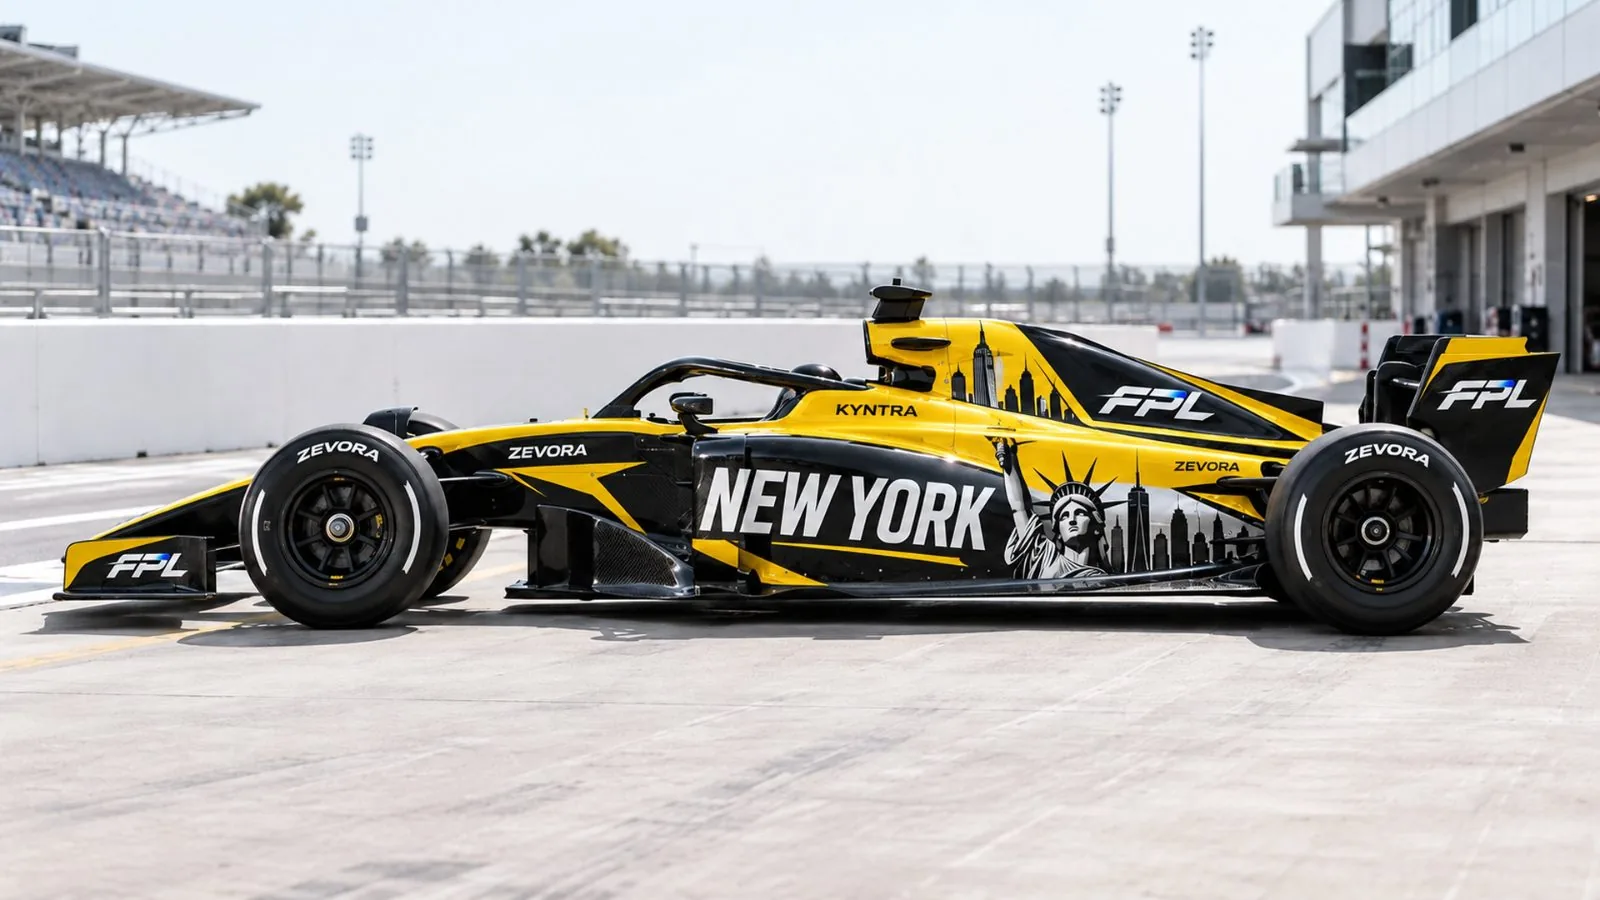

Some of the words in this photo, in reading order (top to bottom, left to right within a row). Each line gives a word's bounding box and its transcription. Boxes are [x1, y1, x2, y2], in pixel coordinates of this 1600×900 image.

[1098, 385, 1215, 421] FPL
[1438, 379, 1536, 411] FPL
[835, 403, 918, 418] KYNTRA
[297, 440, 380, 464] ZEVORA
[508, 443, 588, 460] ZEVORA
[1344, 443, 1430, 468] ZEVORA
[1174, 461, 1240, 472] ZEVORA
[699, 467, 842, 537] NEW
[849, 476, 996, 551] YORK
[106, 552, 188, 579] FPL
